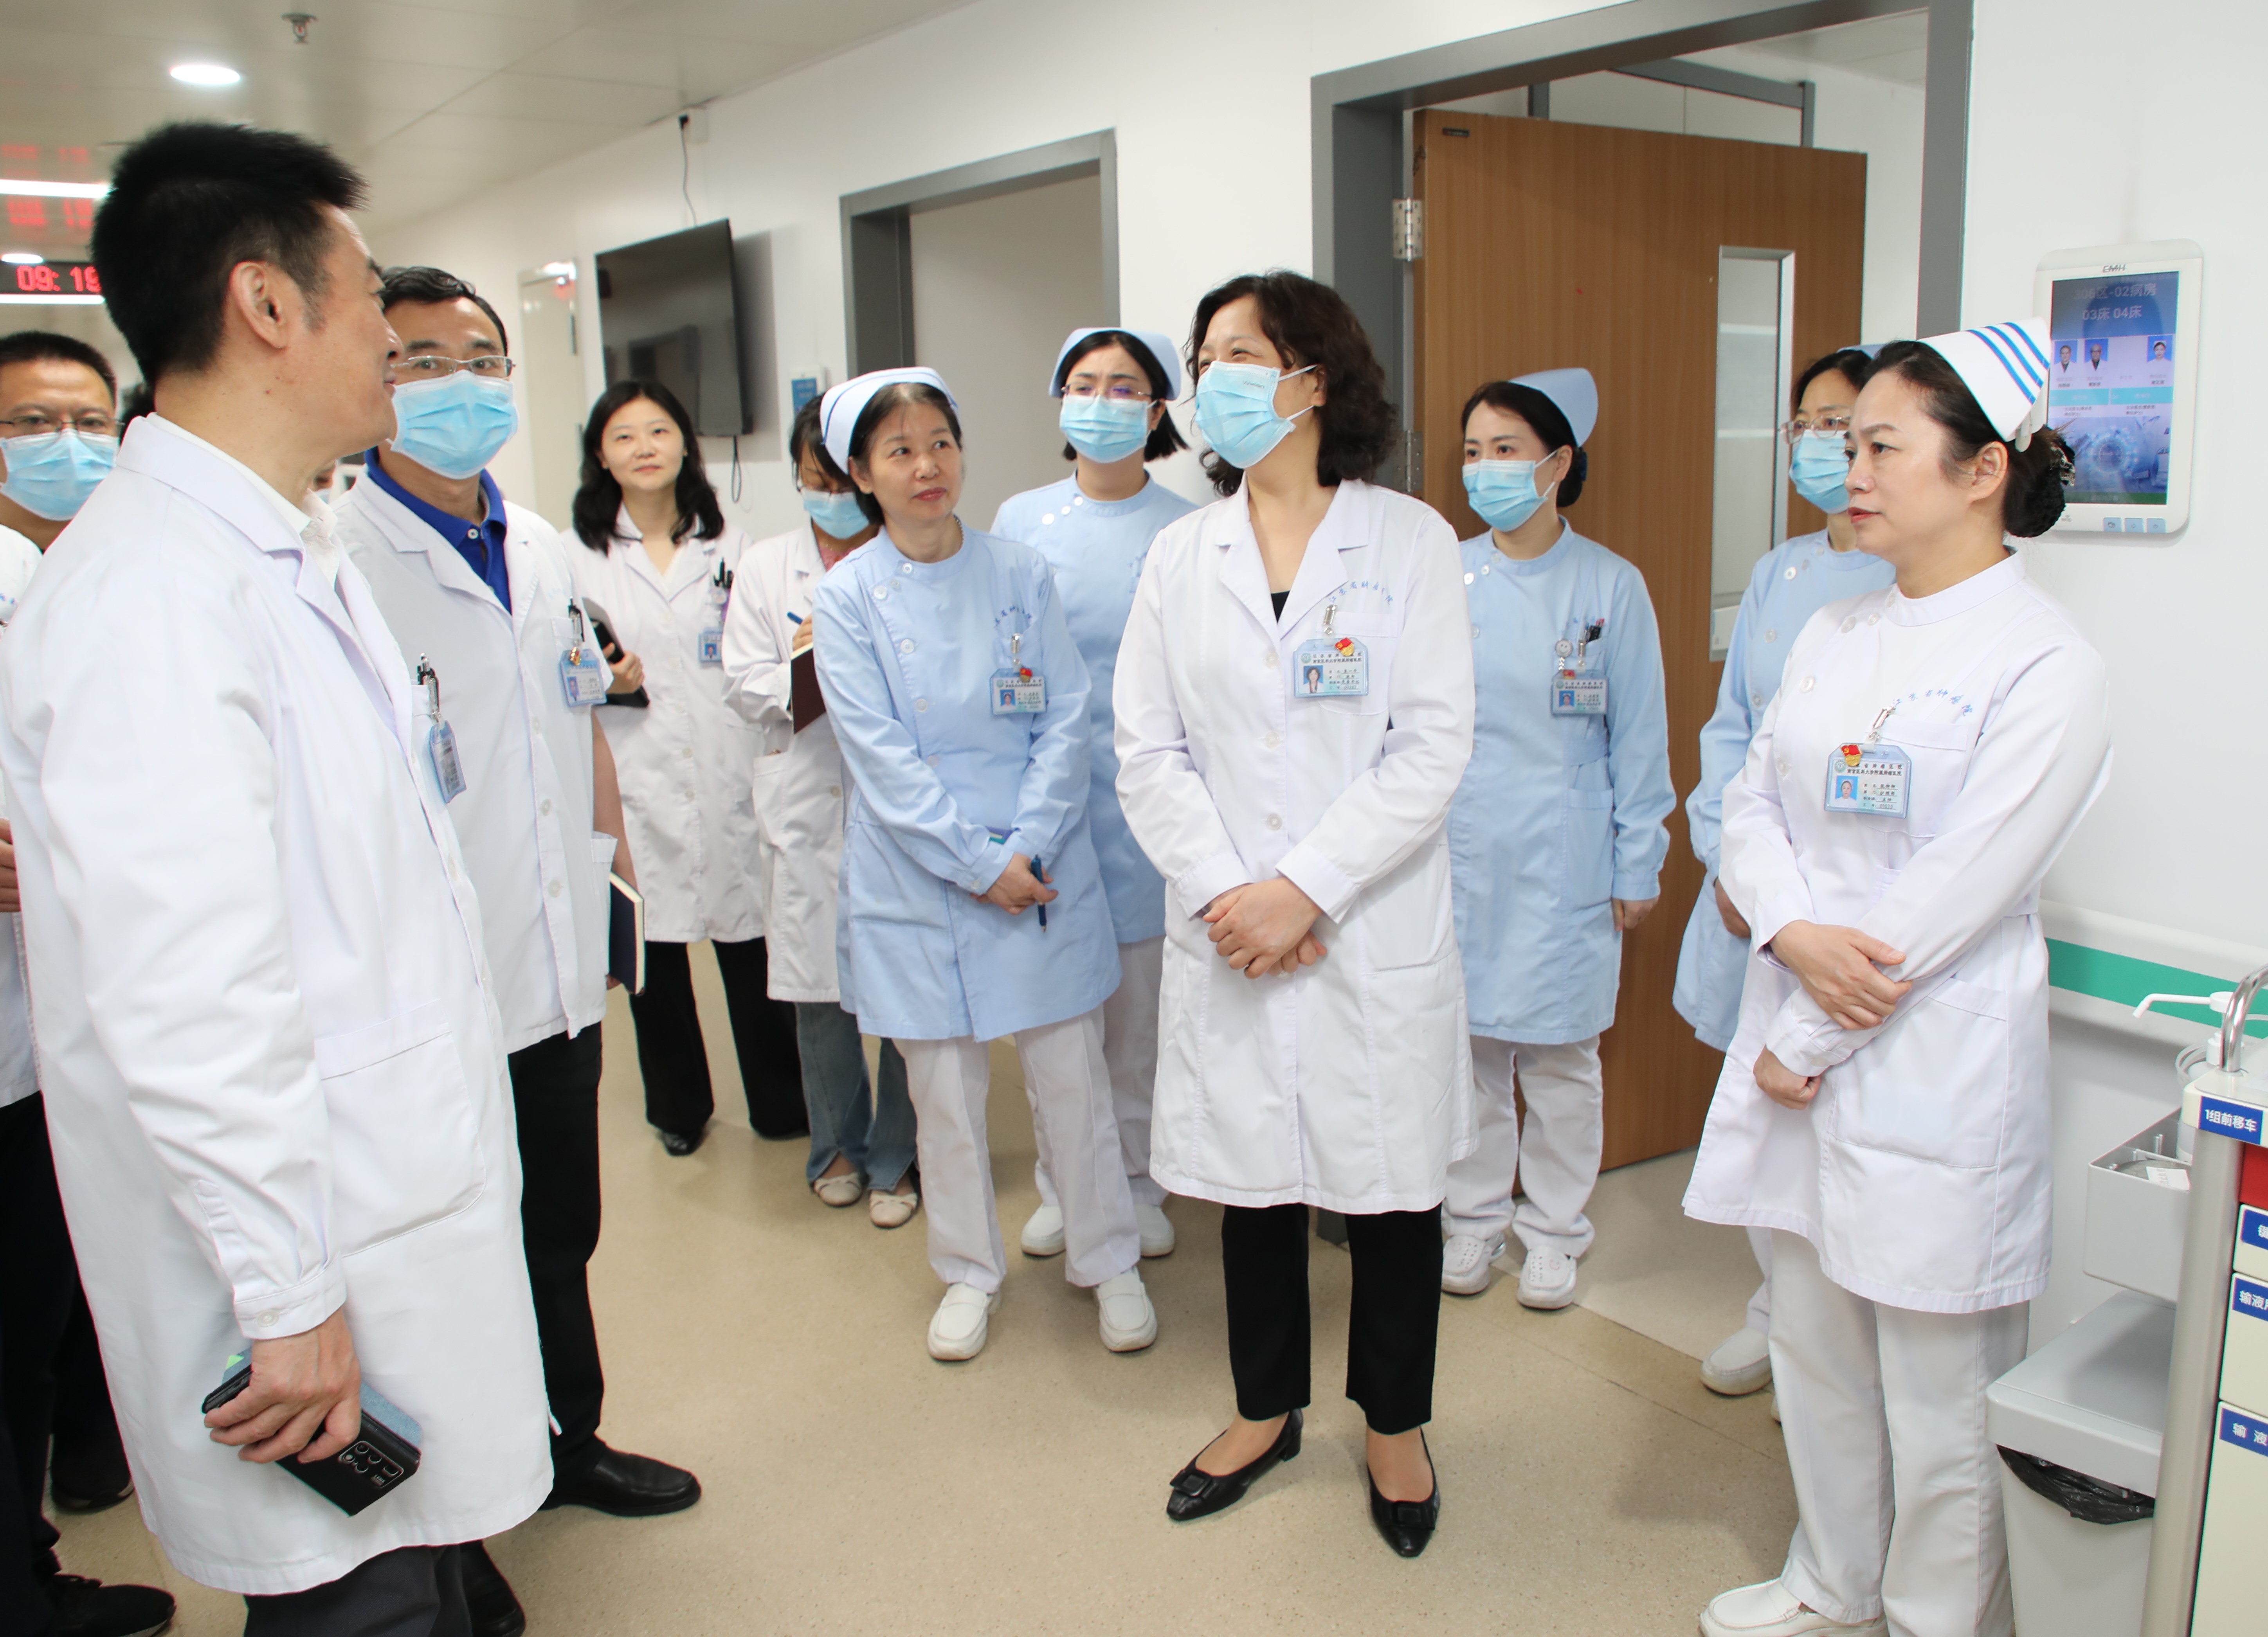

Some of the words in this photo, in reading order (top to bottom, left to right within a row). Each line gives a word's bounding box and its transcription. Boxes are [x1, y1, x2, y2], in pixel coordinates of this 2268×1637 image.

[2082, 307, 2110, 320] 03床
[2113, 305, 2142, 319] 04床
[2205, 1109, 2257, 1132] 1组前移车
